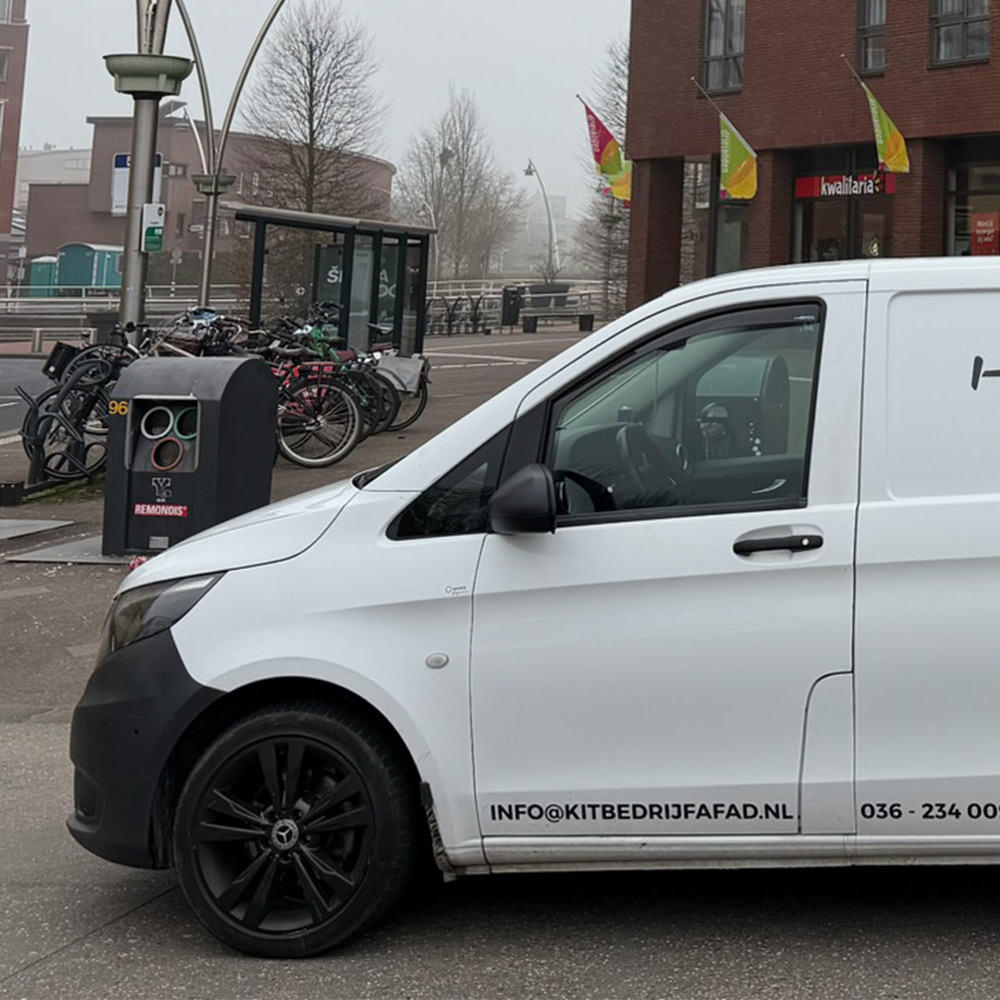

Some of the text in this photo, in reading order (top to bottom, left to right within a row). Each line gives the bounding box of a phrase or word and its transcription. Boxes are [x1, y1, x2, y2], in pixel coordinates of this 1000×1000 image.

[820, 175, 874, 196] kwalitaria
[108, 400, 129, 416] 96
[490, 802, 794, 823] INFO@KITBEDRIJFAFAD.NL
[860, 802, 903, 821] 036
[921, 802, 962, 821] 234
